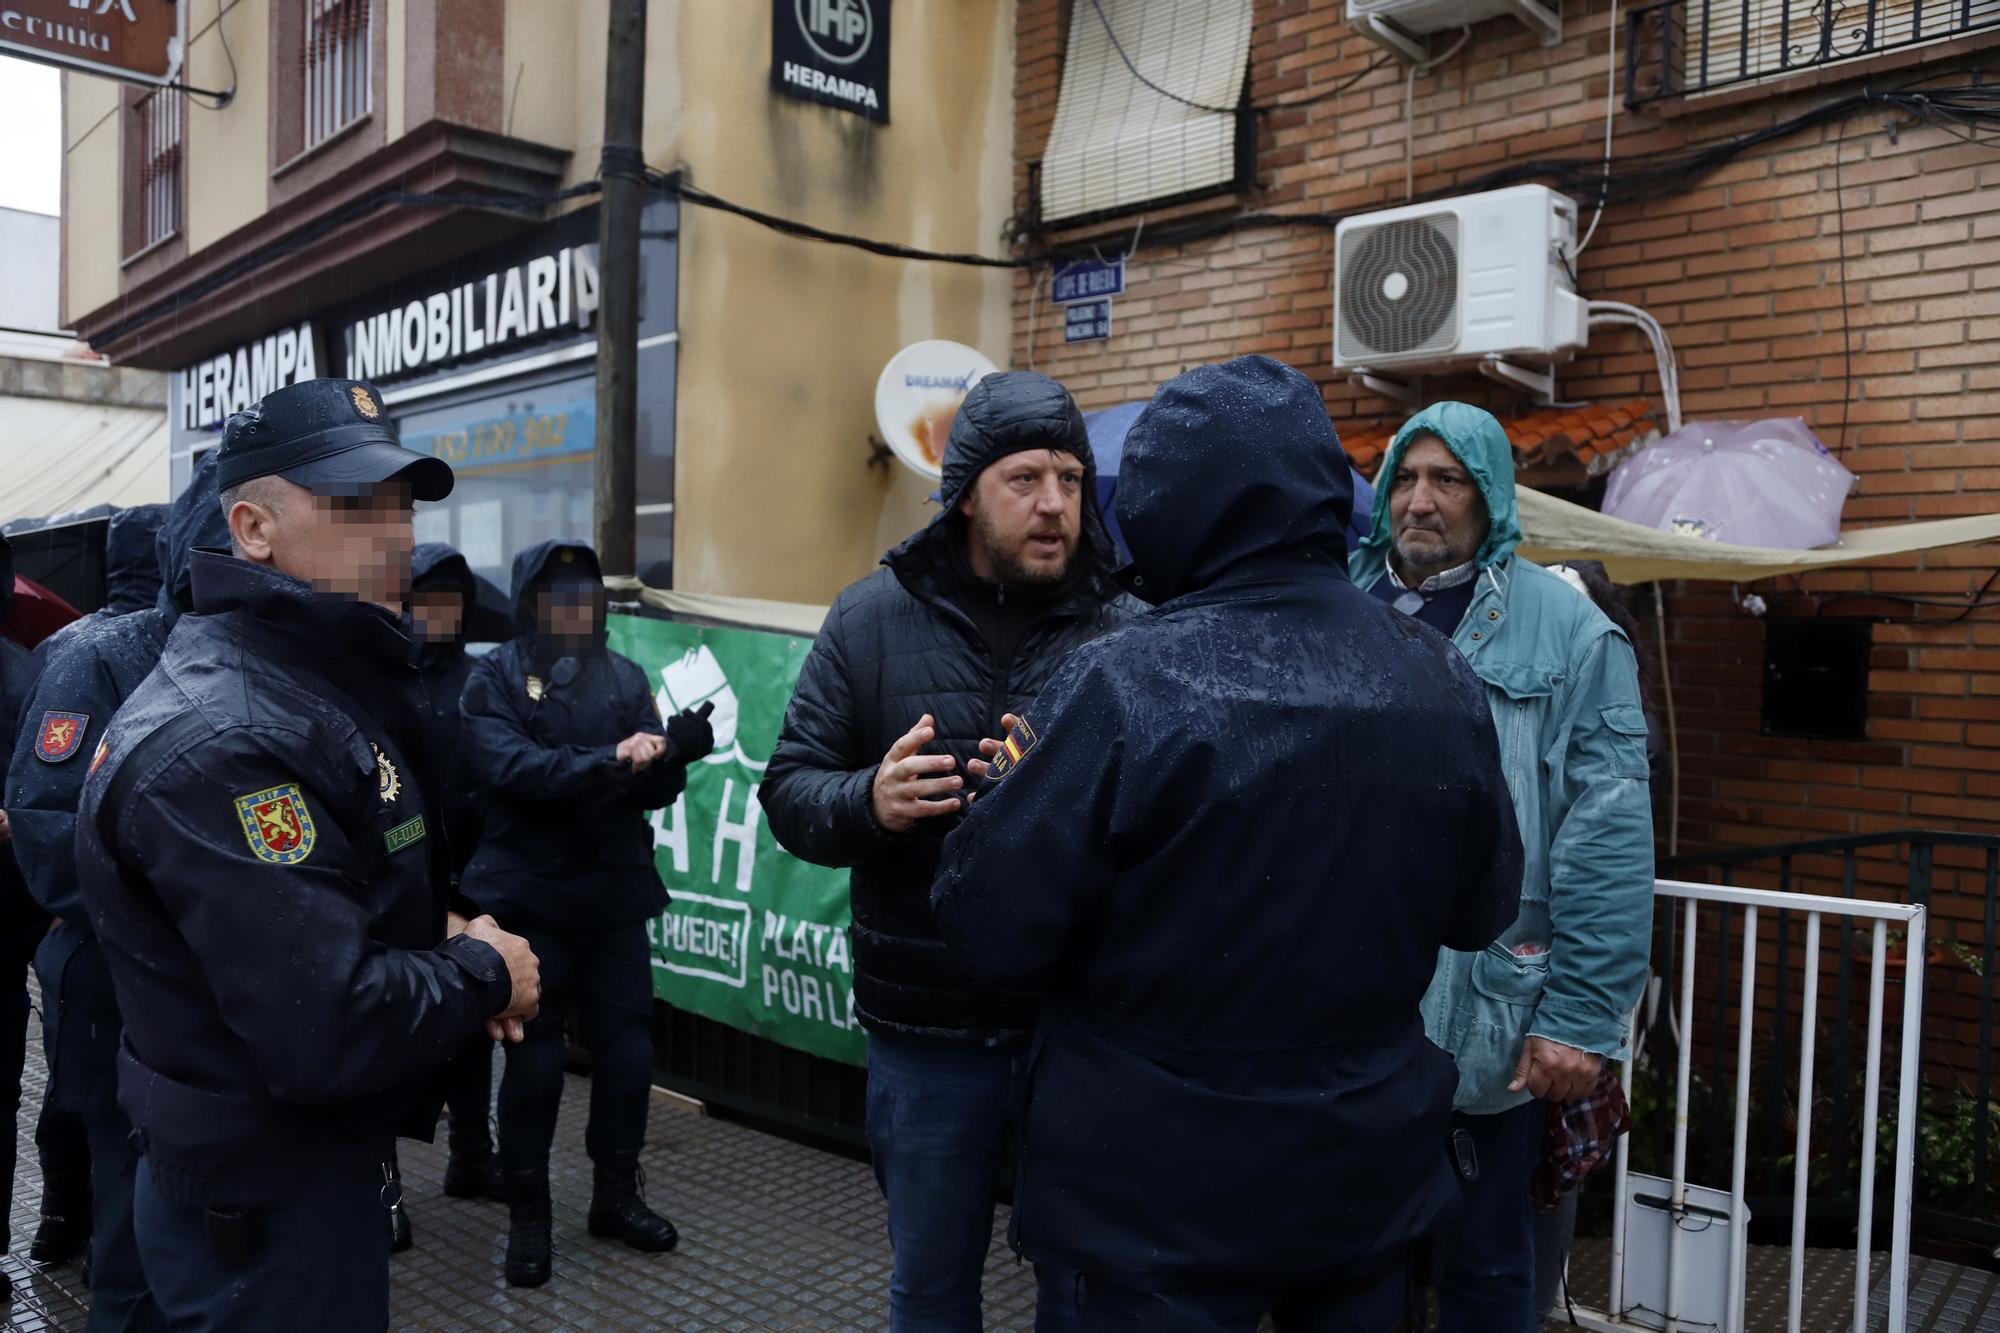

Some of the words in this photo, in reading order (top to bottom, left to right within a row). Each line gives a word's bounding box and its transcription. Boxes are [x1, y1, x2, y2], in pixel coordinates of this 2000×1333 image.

[783, 60, 879, 109] HERAMPA
[181, 321, 317, 431] HERAMPA
[662, 910, 741, 969] PUEDE!
[762, 963, 824, 1022] POR
